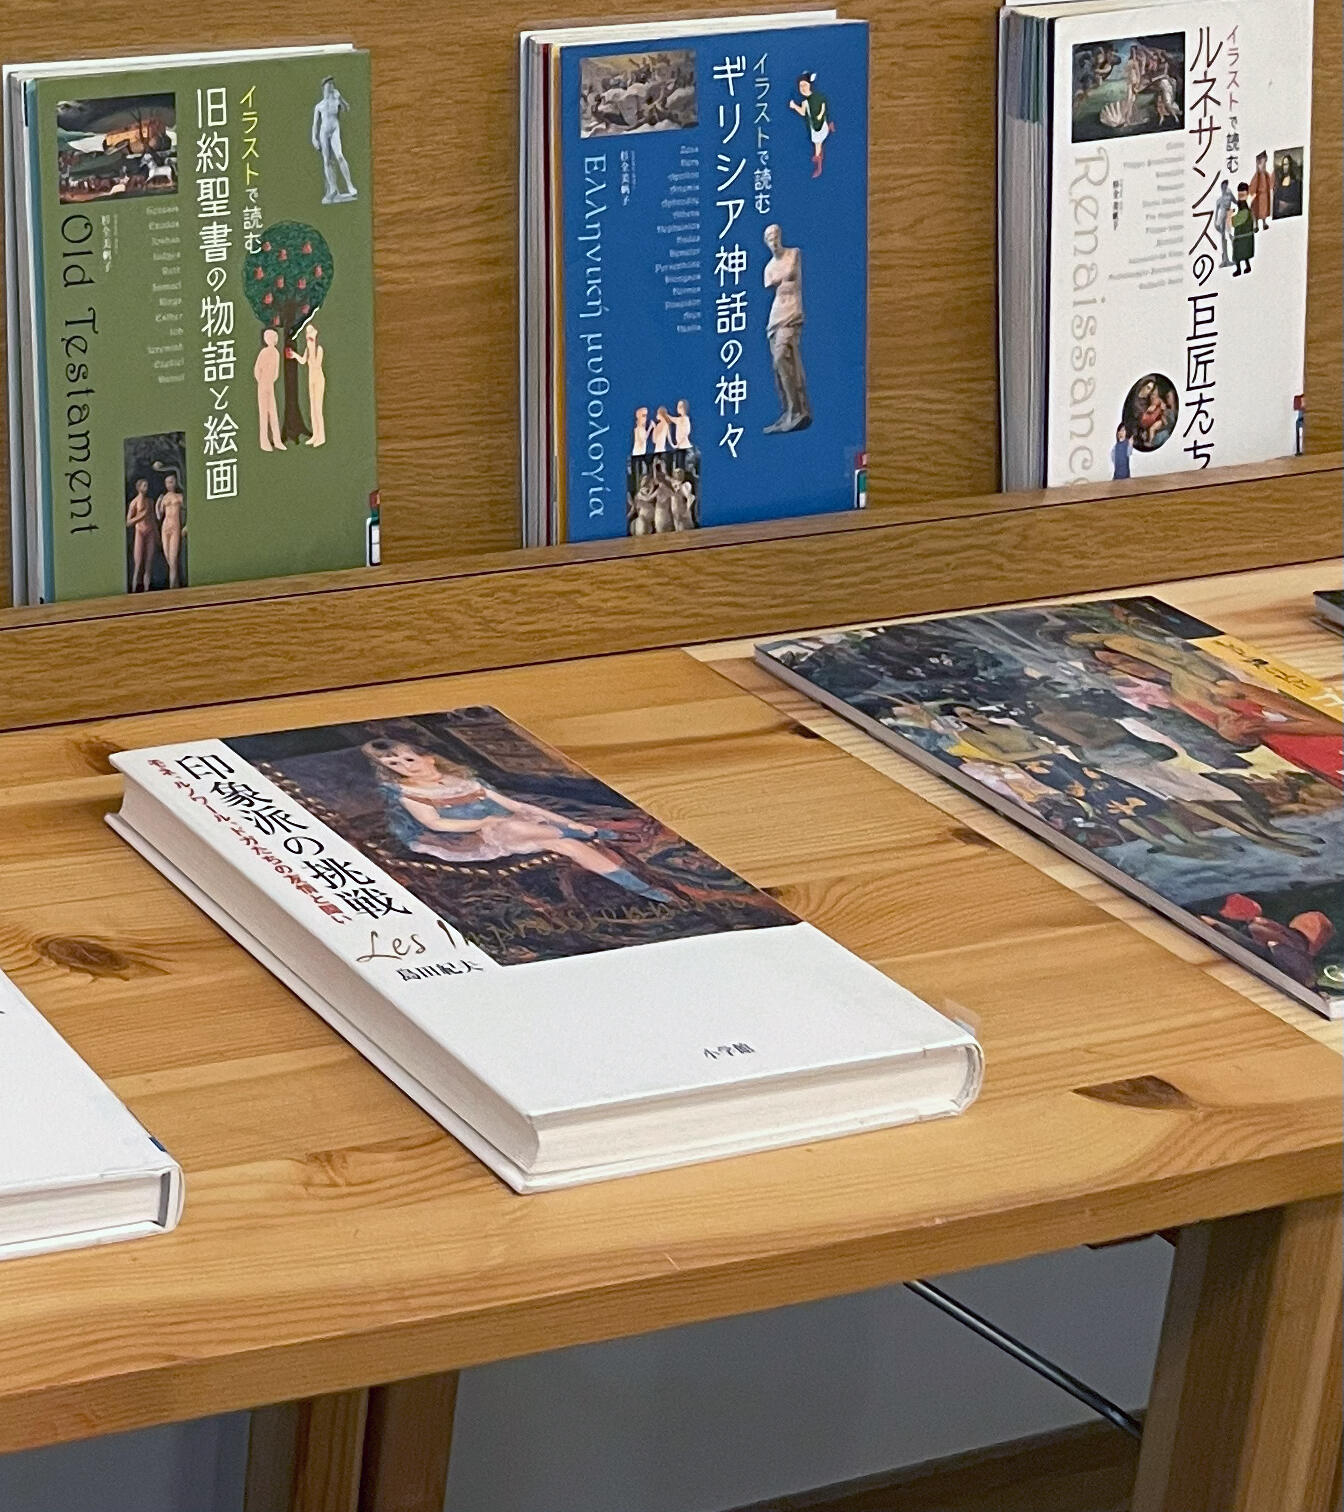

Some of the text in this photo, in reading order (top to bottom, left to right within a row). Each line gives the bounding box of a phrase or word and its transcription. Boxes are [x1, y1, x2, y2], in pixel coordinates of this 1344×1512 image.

[239, 86, 263, 255] イラストで読む
[753, 51, 772, 215] イラストで読む
[1226, 25, 1242, 175] イラストで読む
[194, 88, 239, 501] 旧約聖書の物語と絵画
[712, 54, 748, 460] ギリシア神話の神々
[1184, 26, 1223, 470] ルネサンスの巨匠たち
[61, 214, 99, 536] Old Testament
[578, 153, 611, 519] Ελληνική μυθολογία
[175, 754, 413, 920] 印象派の挑戦
[356, 930, 427, 963] Les
[395, 958, 484, 982] 島田紀夫
[703, 1041, 756, 1061] 小学館
